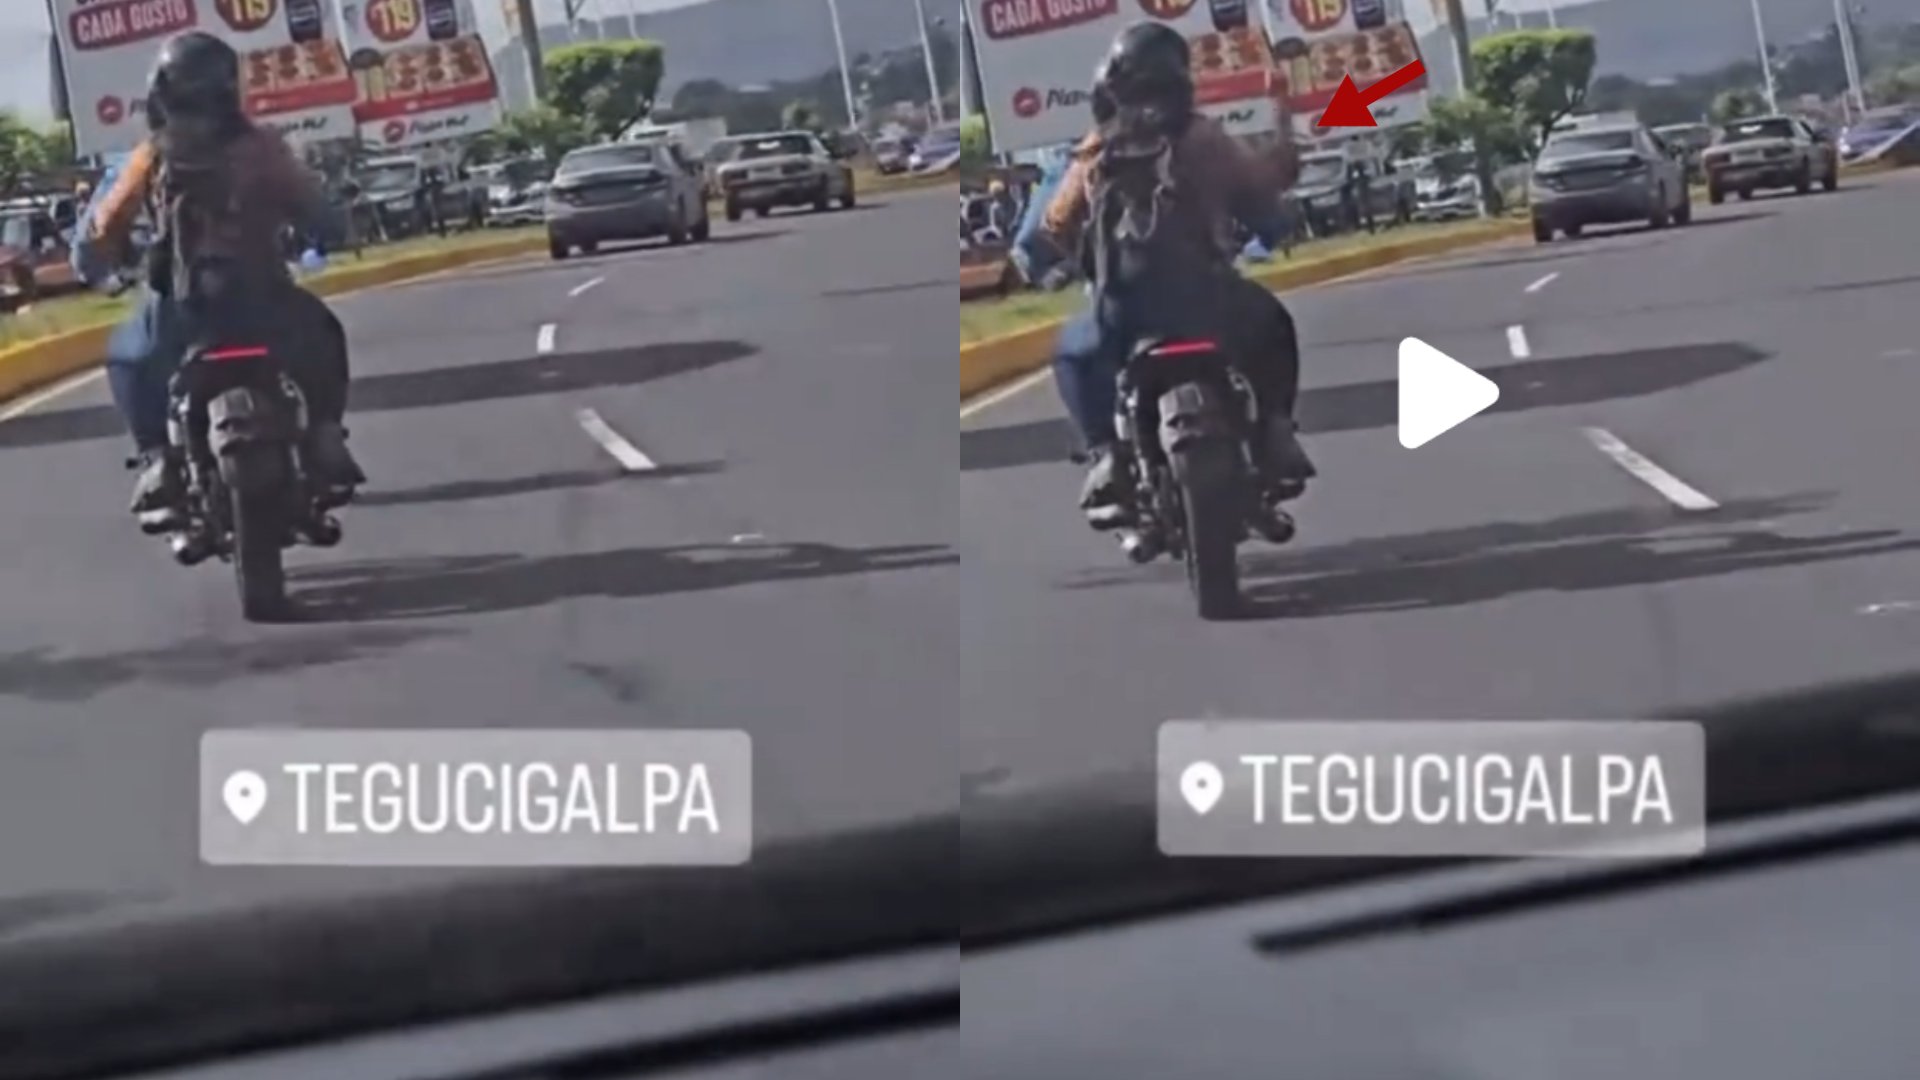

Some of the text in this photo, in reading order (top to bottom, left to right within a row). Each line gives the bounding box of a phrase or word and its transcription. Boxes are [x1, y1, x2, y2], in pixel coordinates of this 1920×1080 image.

[77, 0, 188, 43] CADA GUSTO
[990, 0, 1043, 33] CADA
